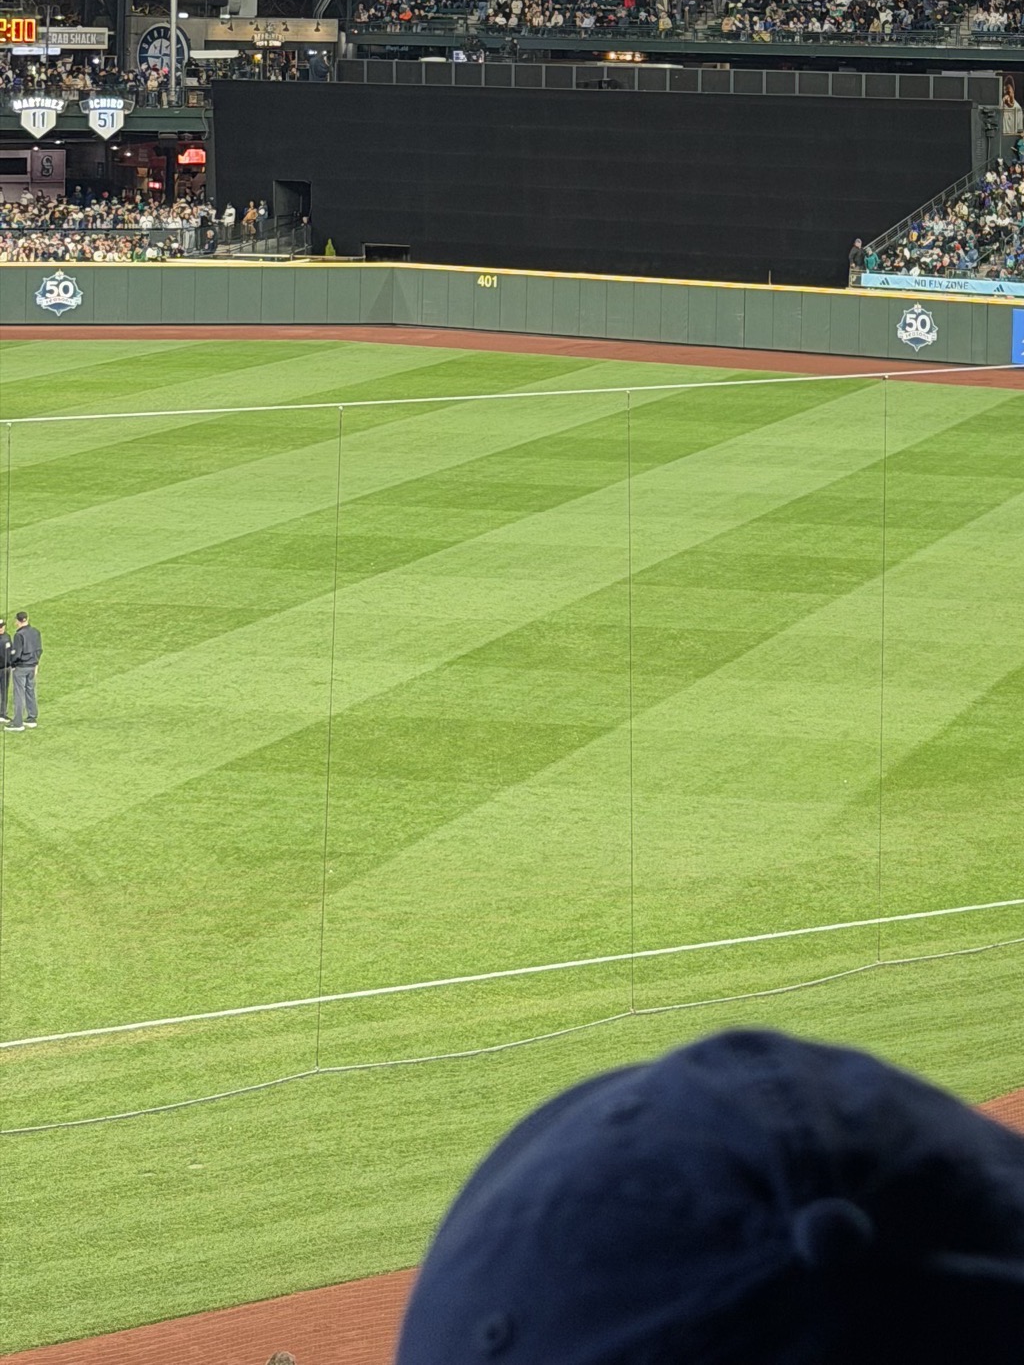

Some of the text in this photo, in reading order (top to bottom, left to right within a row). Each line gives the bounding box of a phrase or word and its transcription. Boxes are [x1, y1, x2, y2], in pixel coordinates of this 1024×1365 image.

[70, 34, 97, 44] SHACK
[12, 97, 65, 110] MARTINEZ
[89, 98, 124, 109] ICHIRO
[31, 111, 46, 128] 11
[97, 112, 115, 128] 51
[477, 274, 498, 288] 401
[914, 279, 969, 290] NO FLY ZONE
[45, 280, 74, 297] 50
[905, 313, 931, 333] 50
